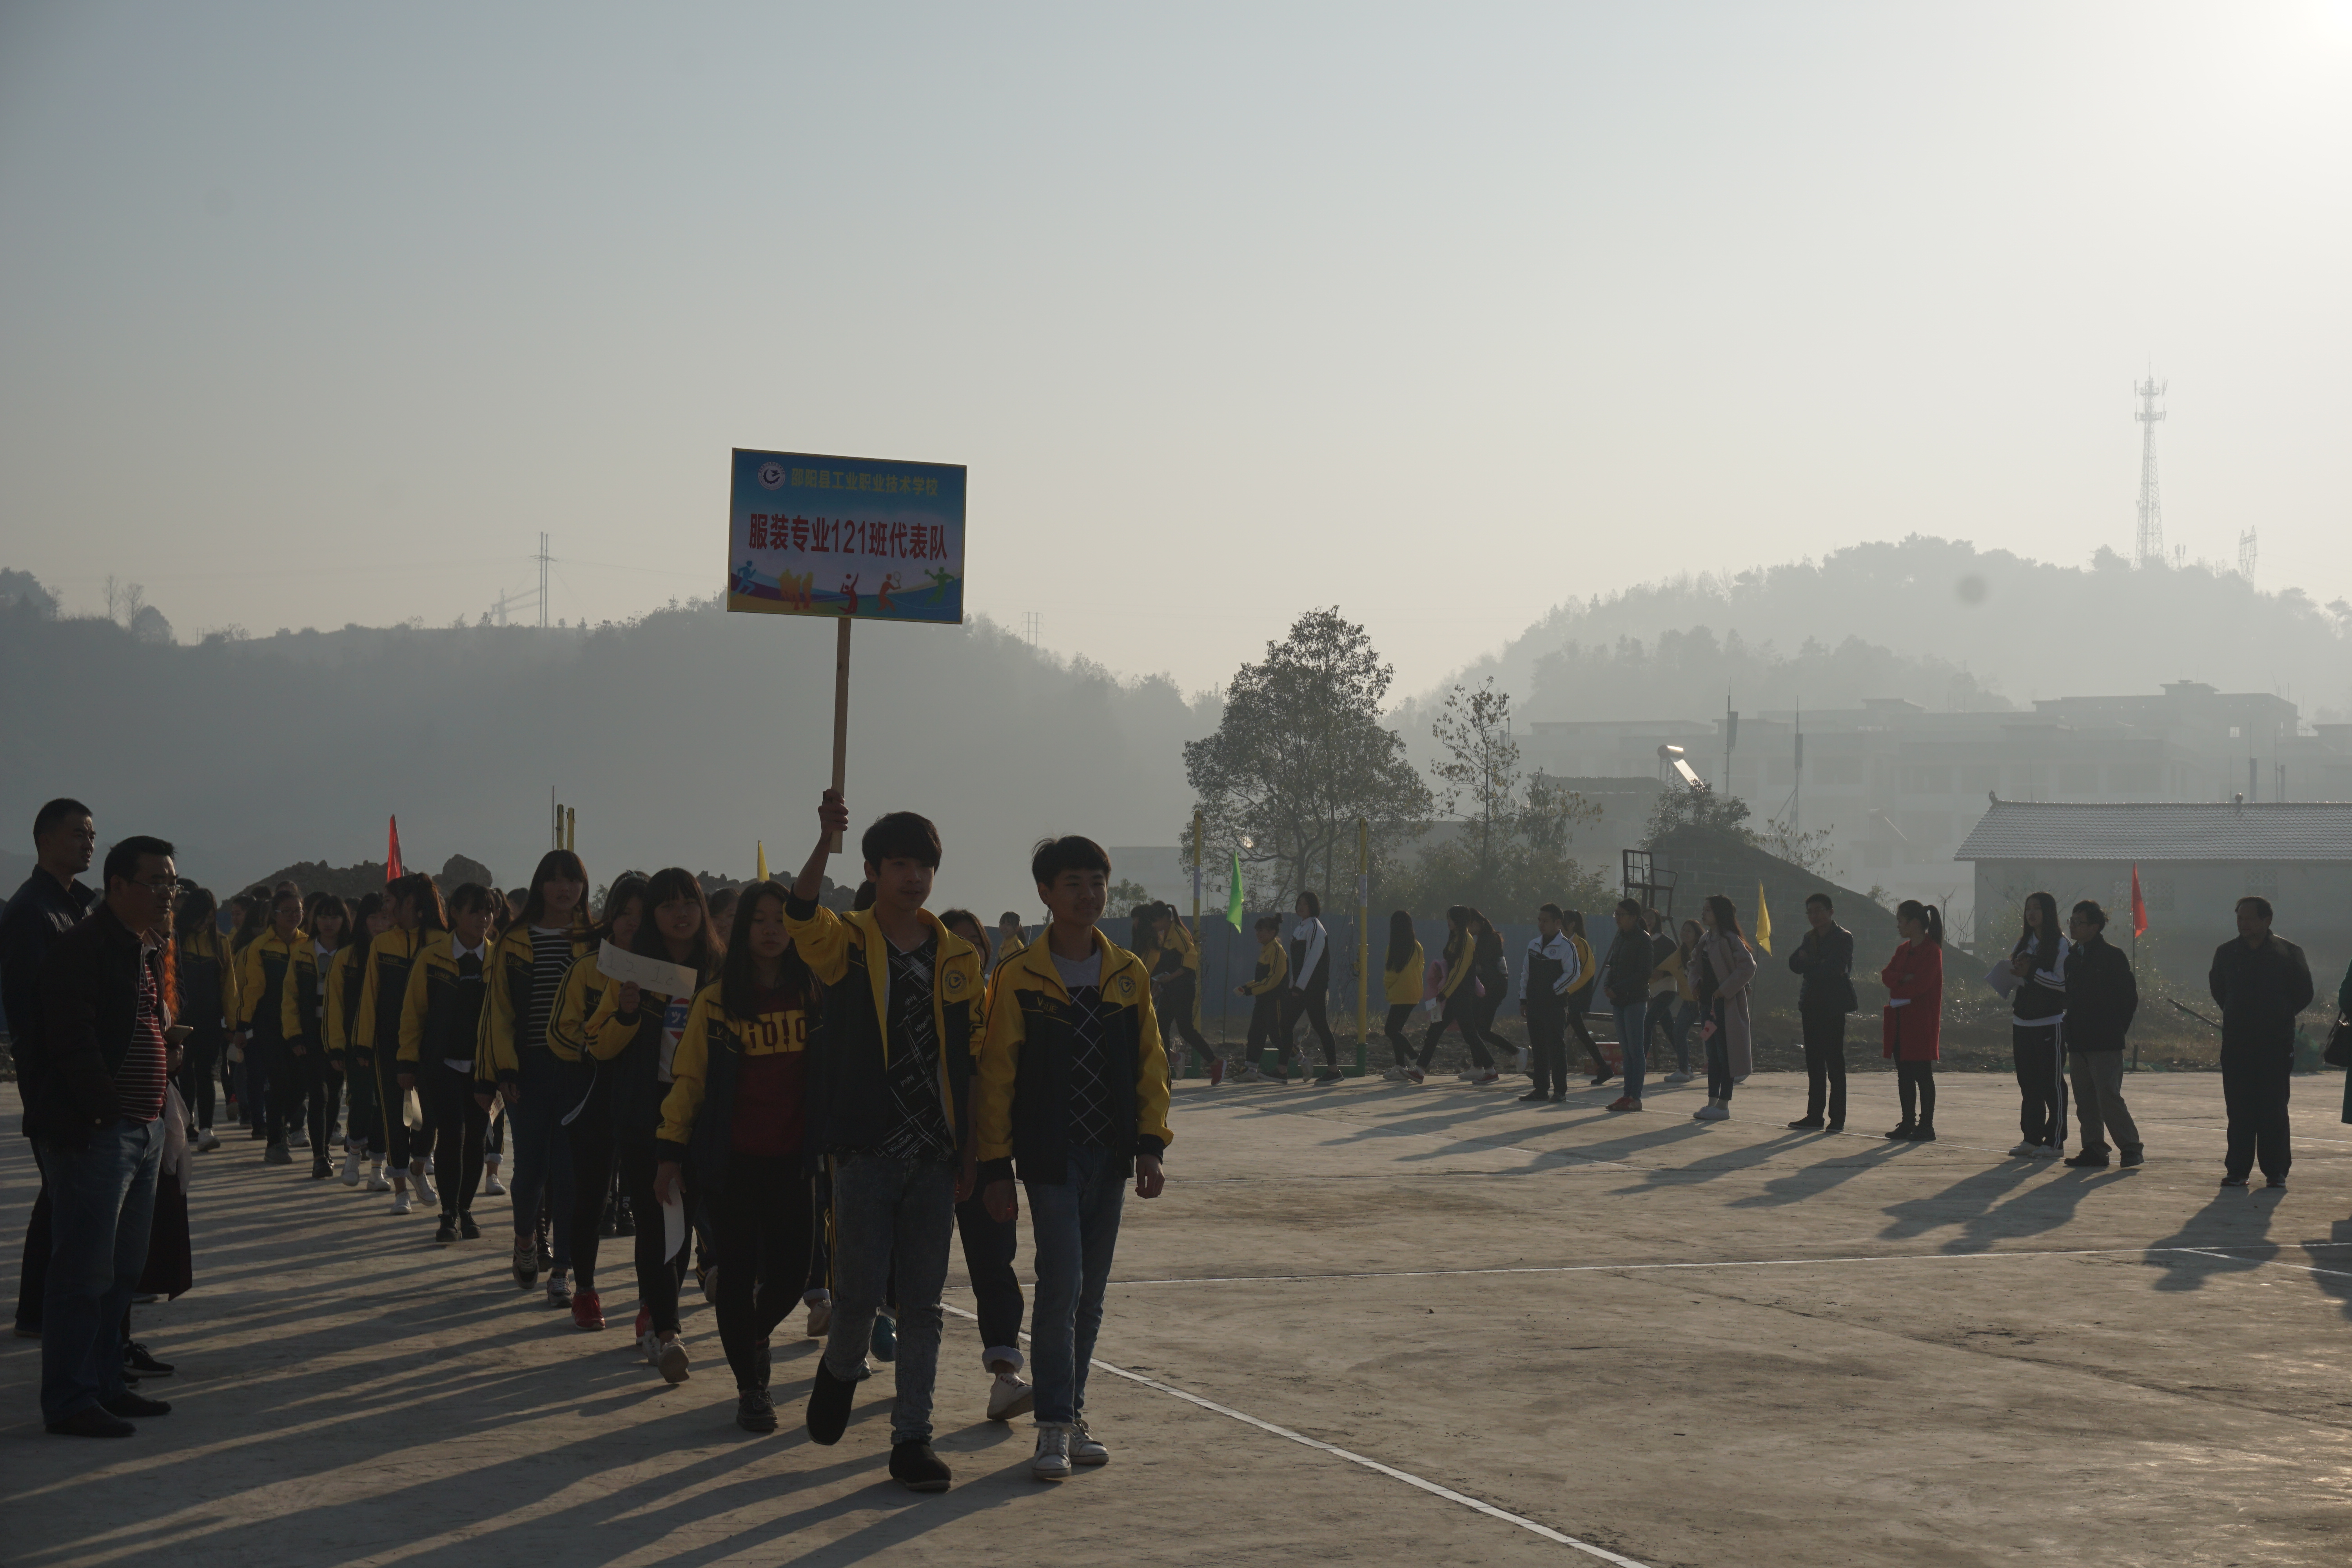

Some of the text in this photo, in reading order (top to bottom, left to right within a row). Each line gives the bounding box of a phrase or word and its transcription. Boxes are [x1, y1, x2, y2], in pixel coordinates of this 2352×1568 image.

[791, 467, 938, 497] 邵阳县工业职业技术学校
[749, 513, 947, 561] 服装专业121班代表队
